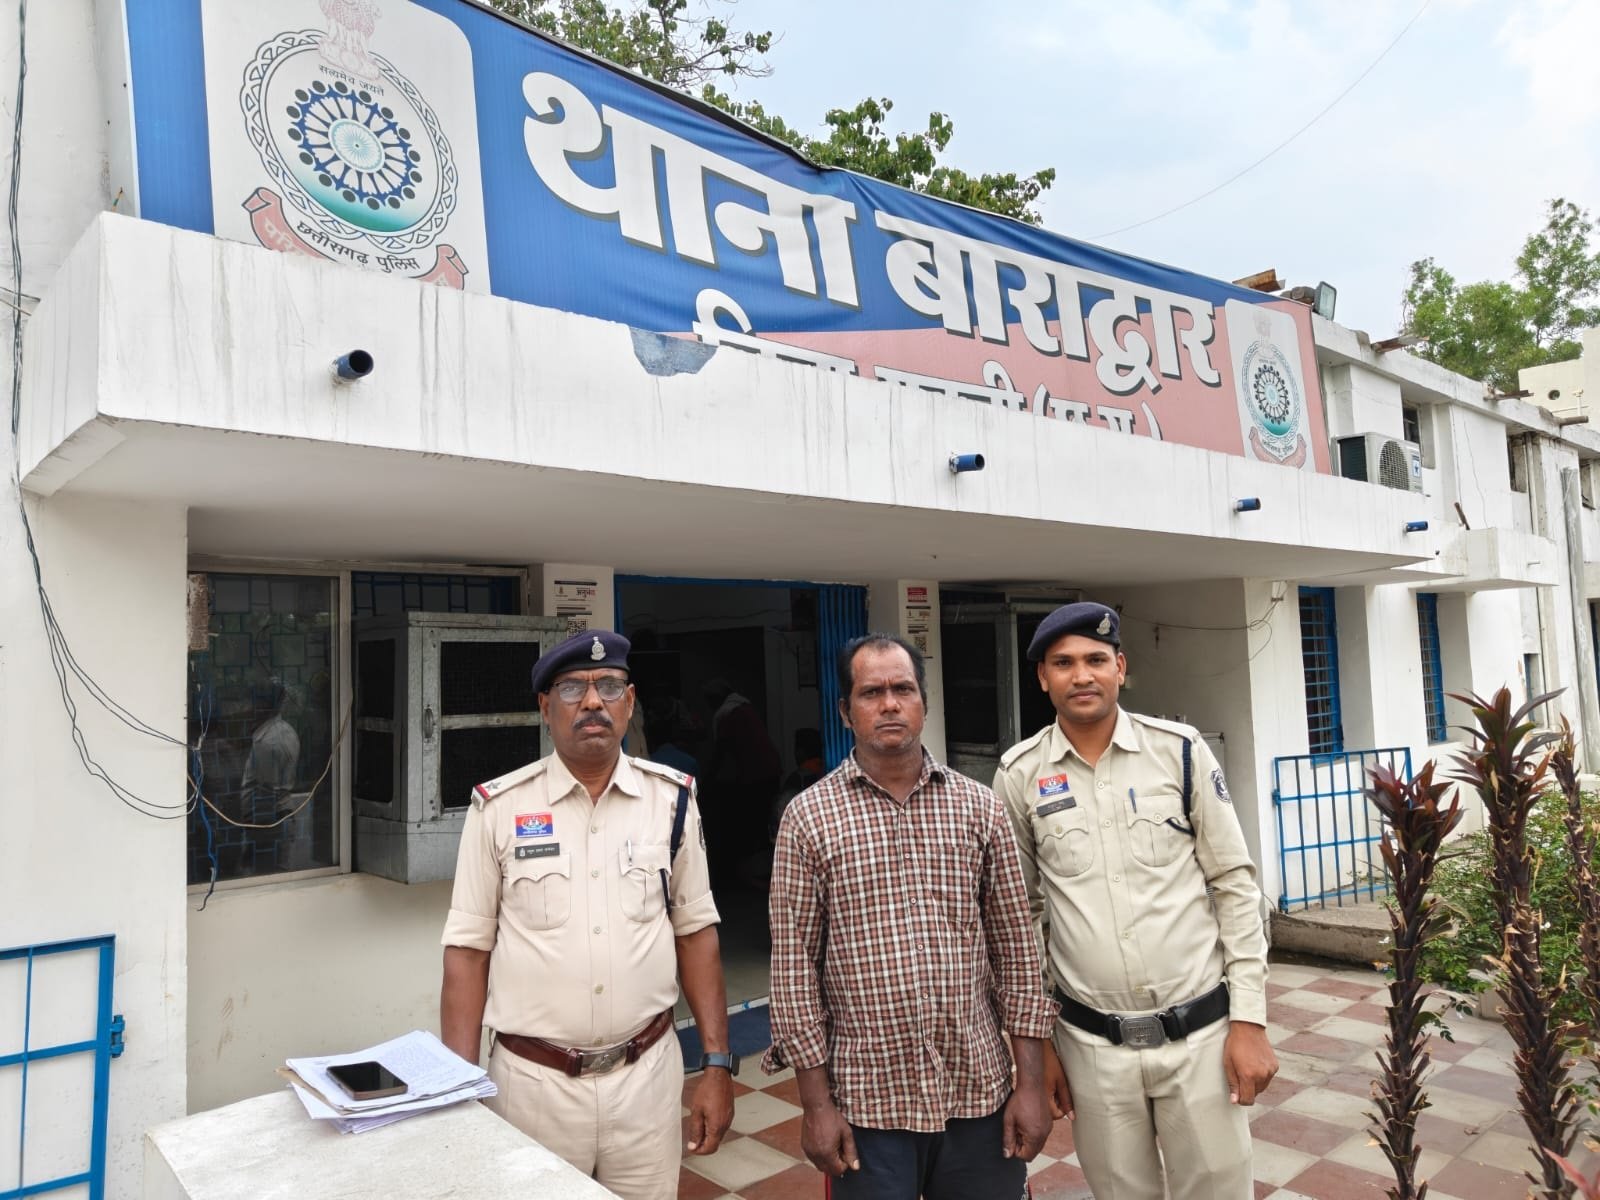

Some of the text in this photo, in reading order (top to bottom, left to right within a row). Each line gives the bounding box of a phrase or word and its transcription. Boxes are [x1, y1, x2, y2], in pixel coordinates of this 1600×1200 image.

[376, 254, 421, 274] पुलिस
[522, 71, 862, 311] थाना
[874, 209, 1222, 396] बाराद्वार
